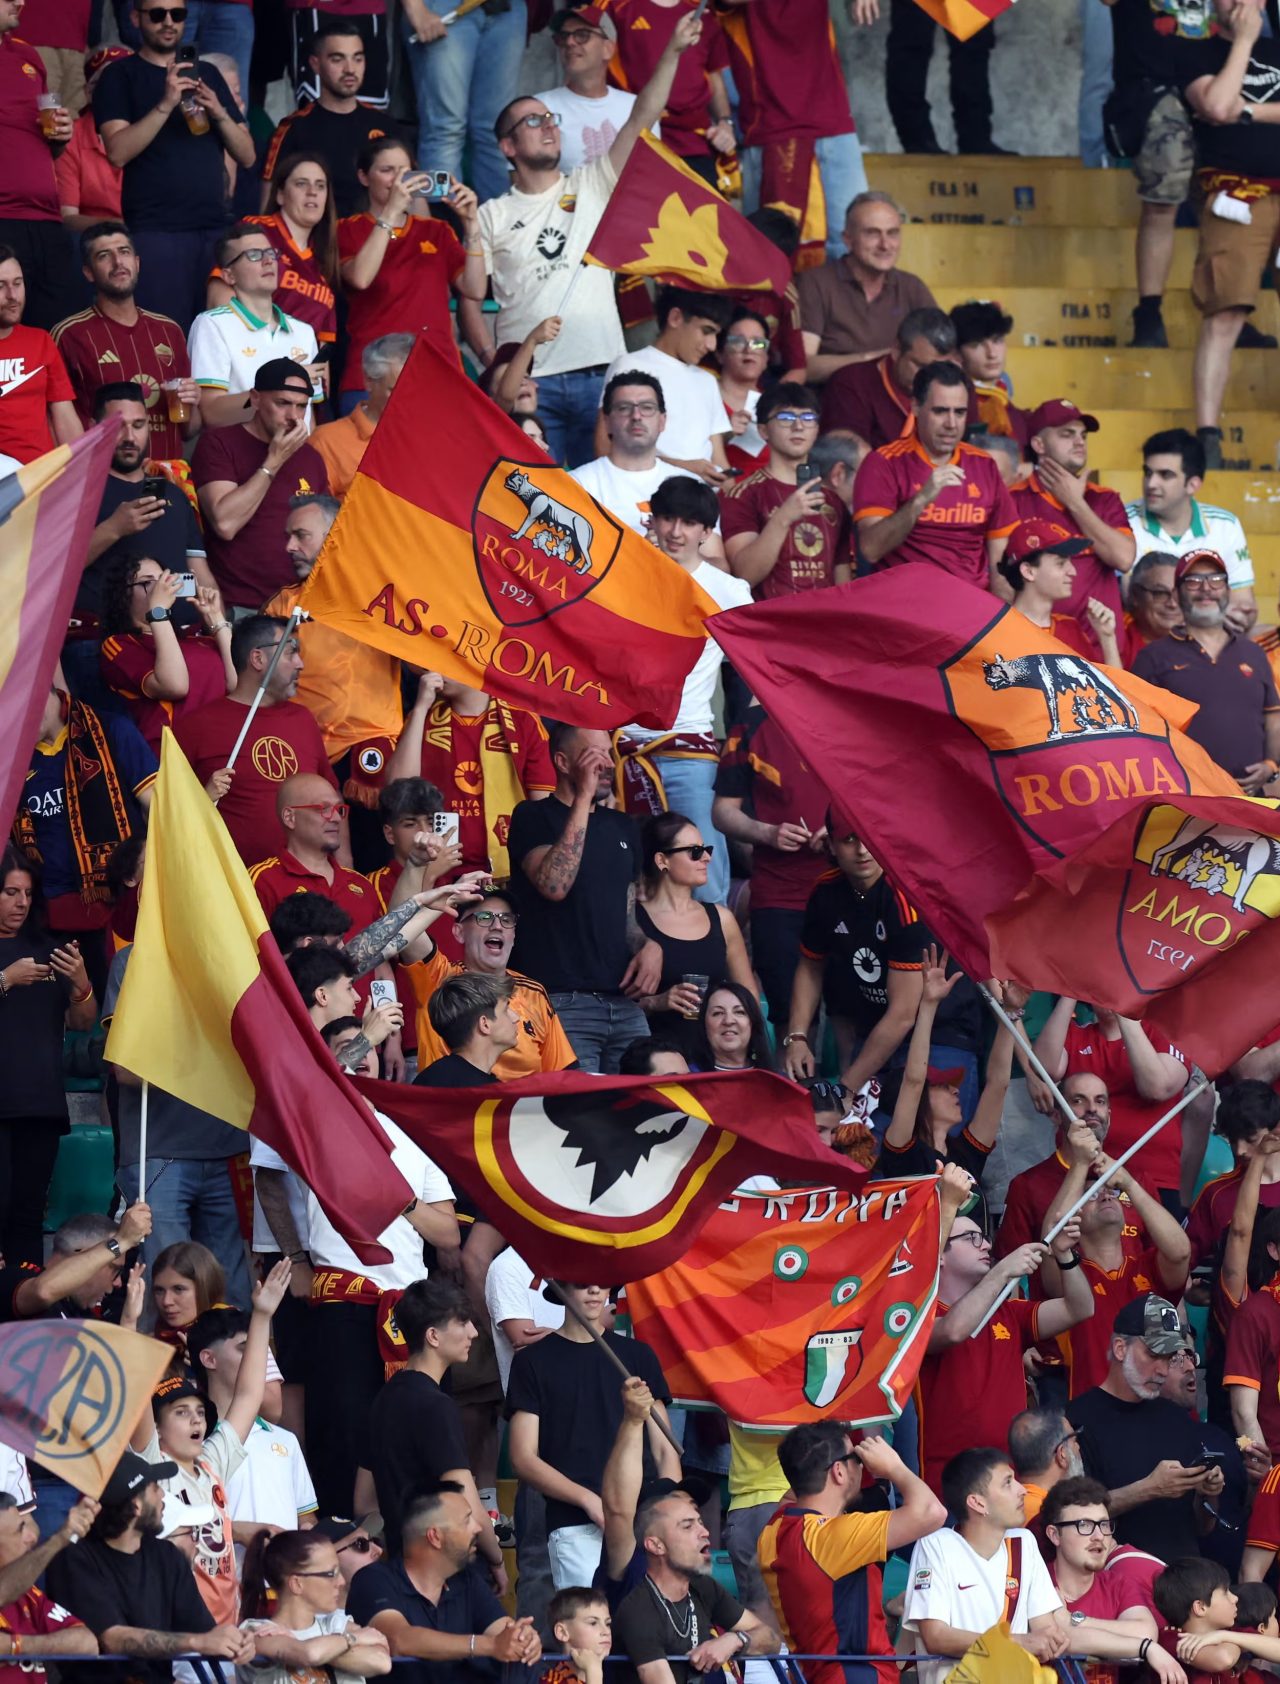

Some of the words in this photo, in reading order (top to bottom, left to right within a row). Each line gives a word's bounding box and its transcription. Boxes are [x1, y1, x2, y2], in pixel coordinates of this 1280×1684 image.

[280, 269, 334, 310] Barilla
[0, 358, 25, 382] IKE
[481, 533, 567, 599] ROMA
[499, 581, 535, 607] 1927
[453, 620, 612, 706] ROMA
[1014, 757, 1184, 816] ROMA
[28, 788, 64, 814] QAT
[452, 800, 480, 808] RIYA
[817, 1335, 834, 1344] 1982
[843, 1335, 853, 1343] 83
